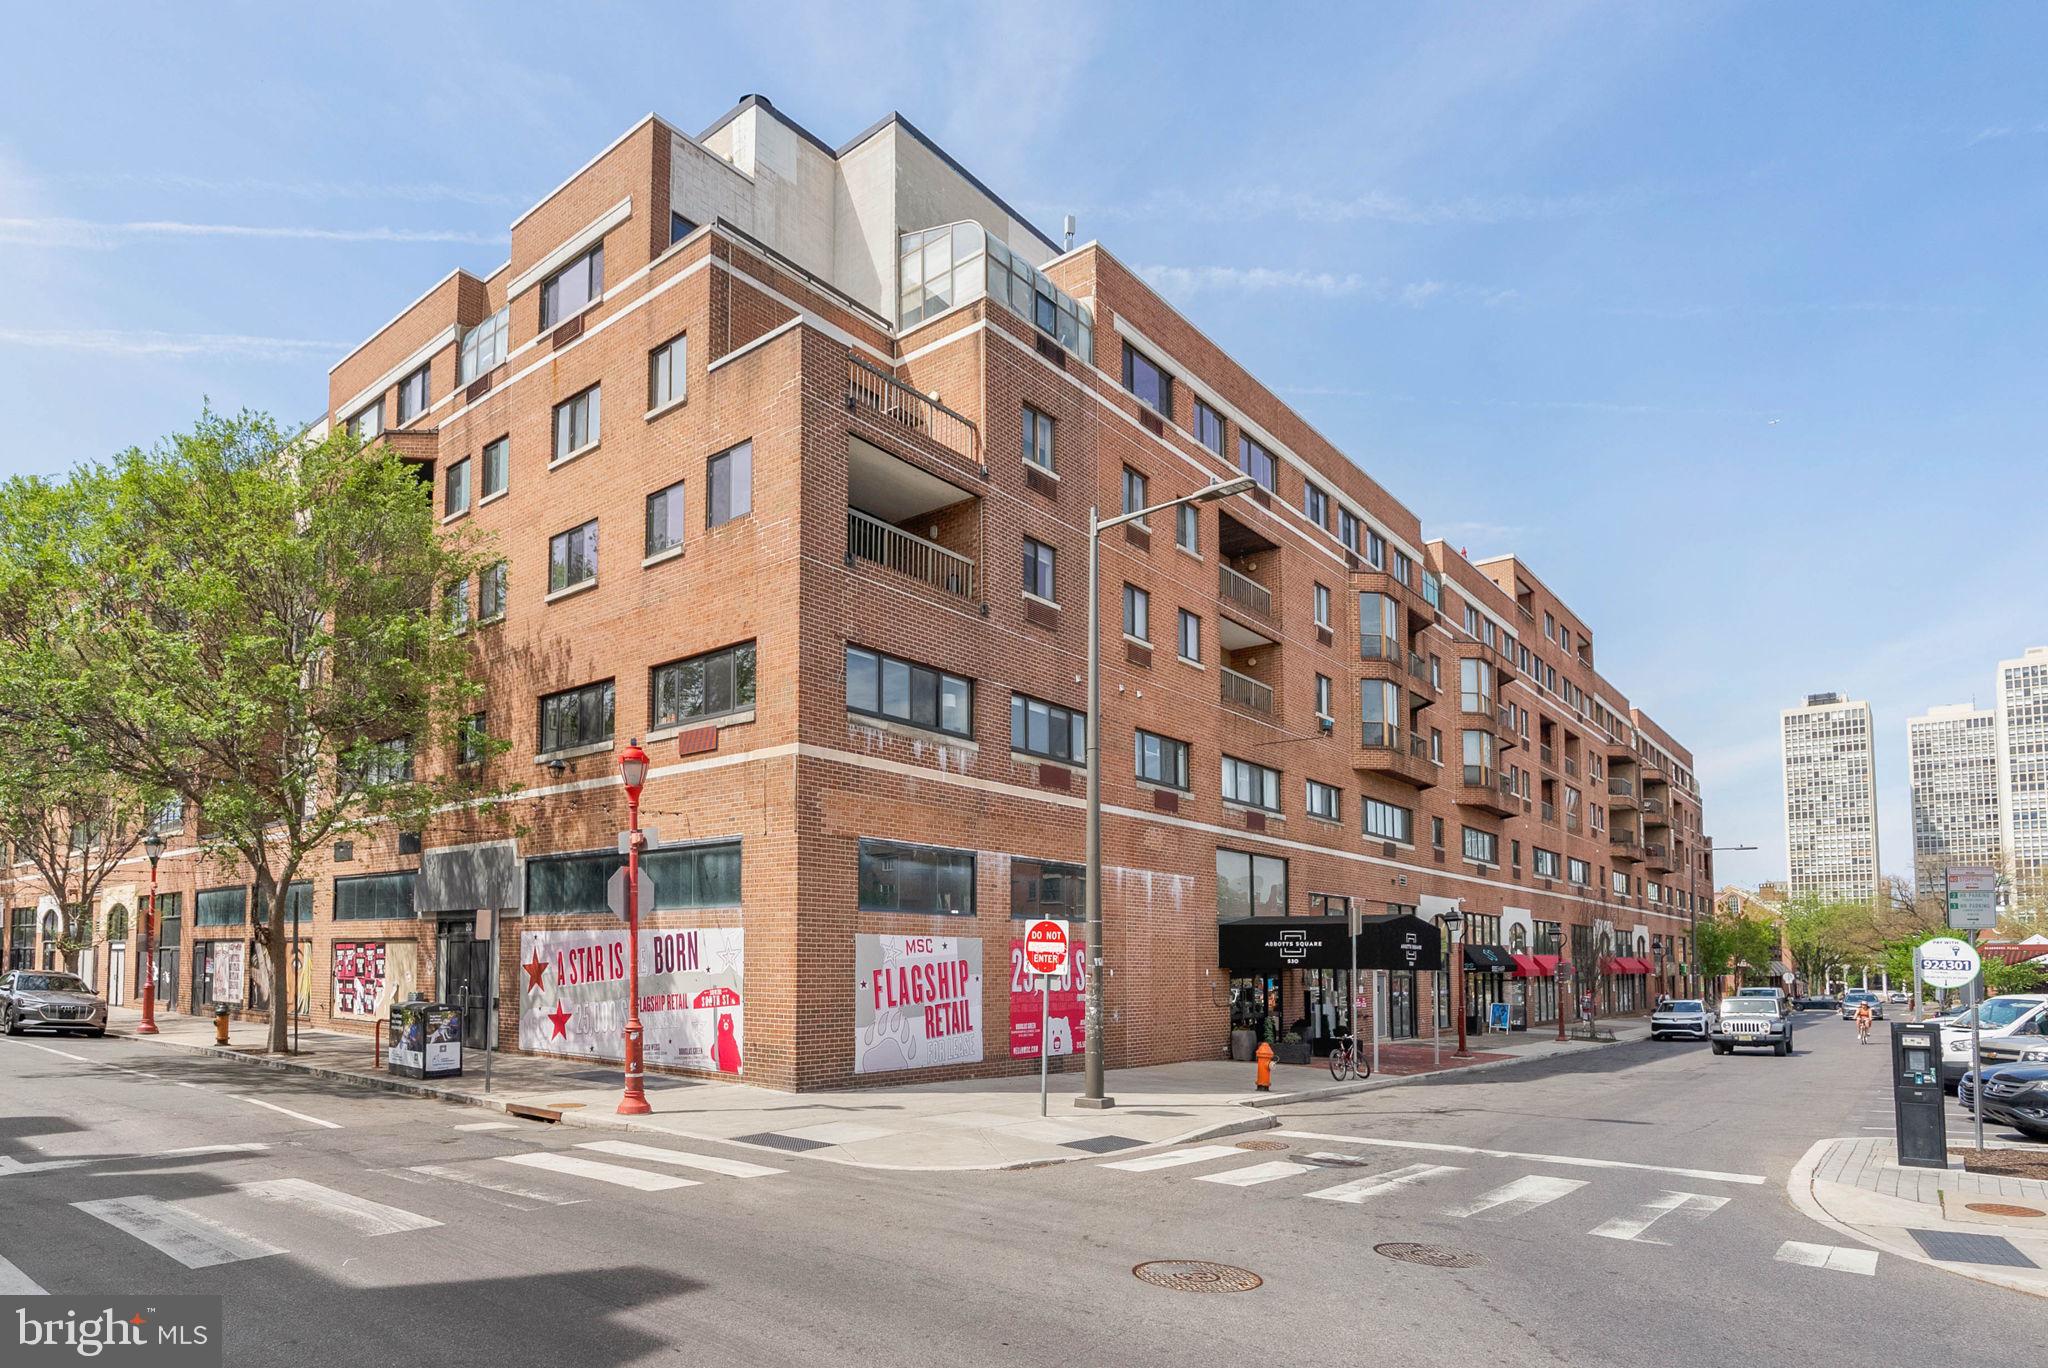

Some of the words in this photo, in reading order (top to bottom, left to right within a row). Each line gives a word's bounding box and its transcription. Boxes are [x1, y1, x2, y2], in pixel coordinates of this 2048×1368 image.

[1031, 930, 1043, 940] DO
[1045, 930, 1062, 940] NOT
[905, 938, 933, 956] MSC
[557, 951, 566, 986] A
[569, 945, 605, 985] STAR
[608, 942, 624, 980] IS
[653, 931, 699, 975] BORN
[1033, 953, 1059, 964] ENTER
[1923, 960, 1971, 971] 924301
[873, 959, 969, 1010] FLAGSHIP
[667, 993, 689, 1011] RETAIL
[924, 1000, 974, 1040] RETAIL
[927, 1040, 946, 1065] FOR
[947, 1033, 976, 1061] LEASE
